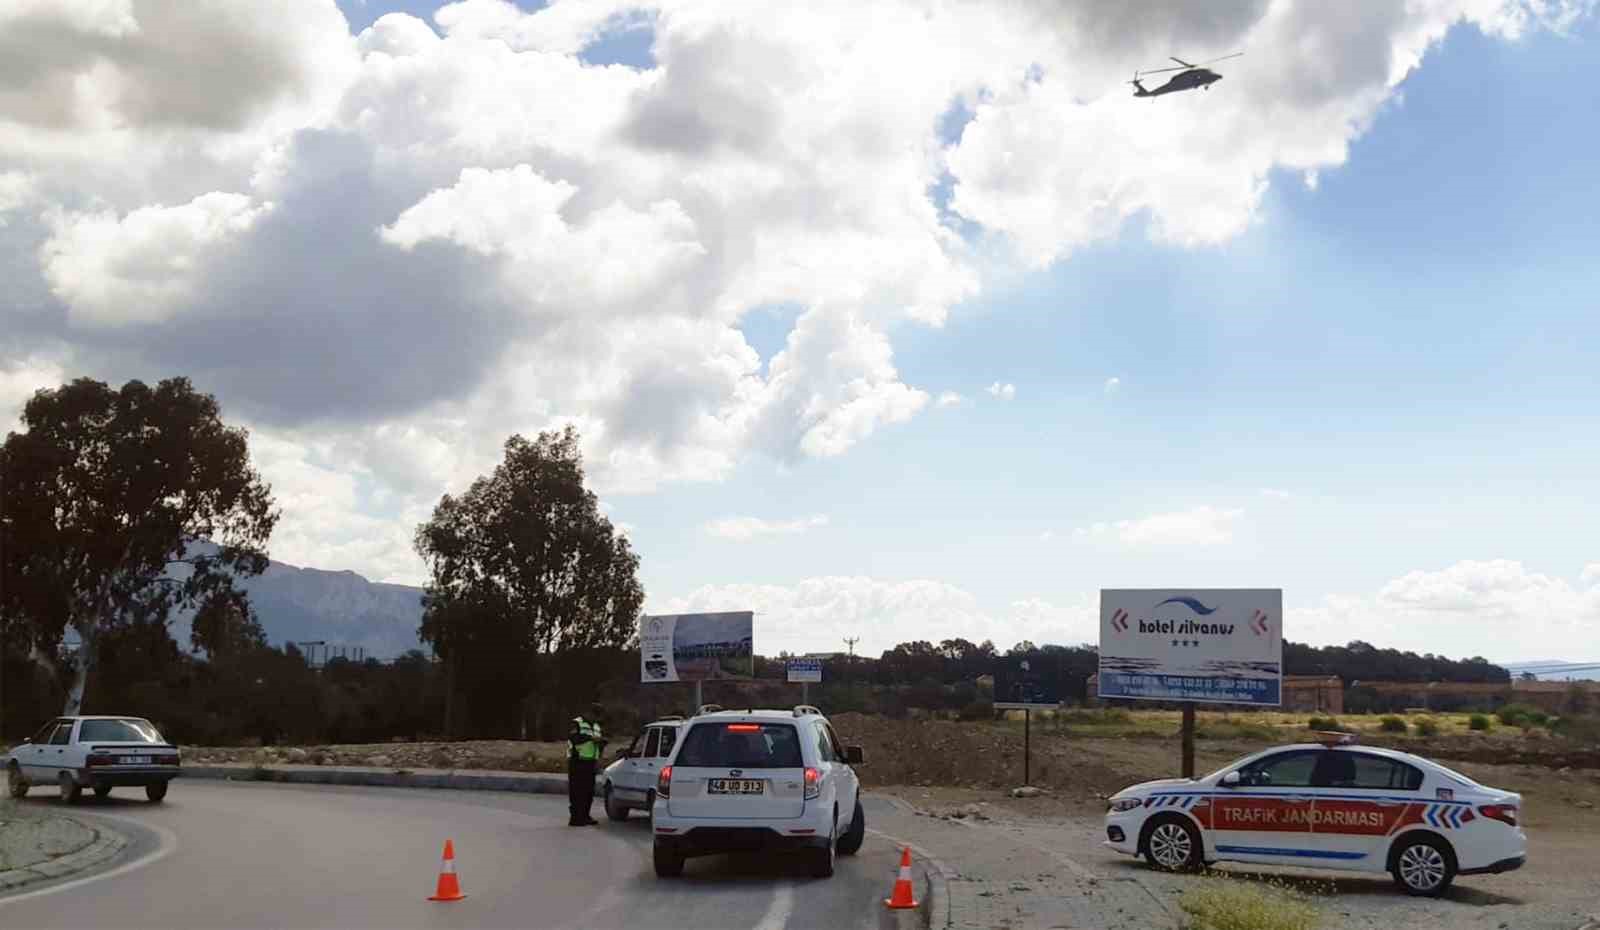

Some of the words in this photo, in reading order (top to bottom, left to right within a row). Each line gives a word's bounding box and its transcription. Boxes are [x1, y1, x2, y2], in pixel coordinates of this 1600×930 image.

[1139, 619, 1174, 634] hotel
[1178, 619, 1234, 635] silvanus
[1281, 809, 1384, 827] JANDARMASI
